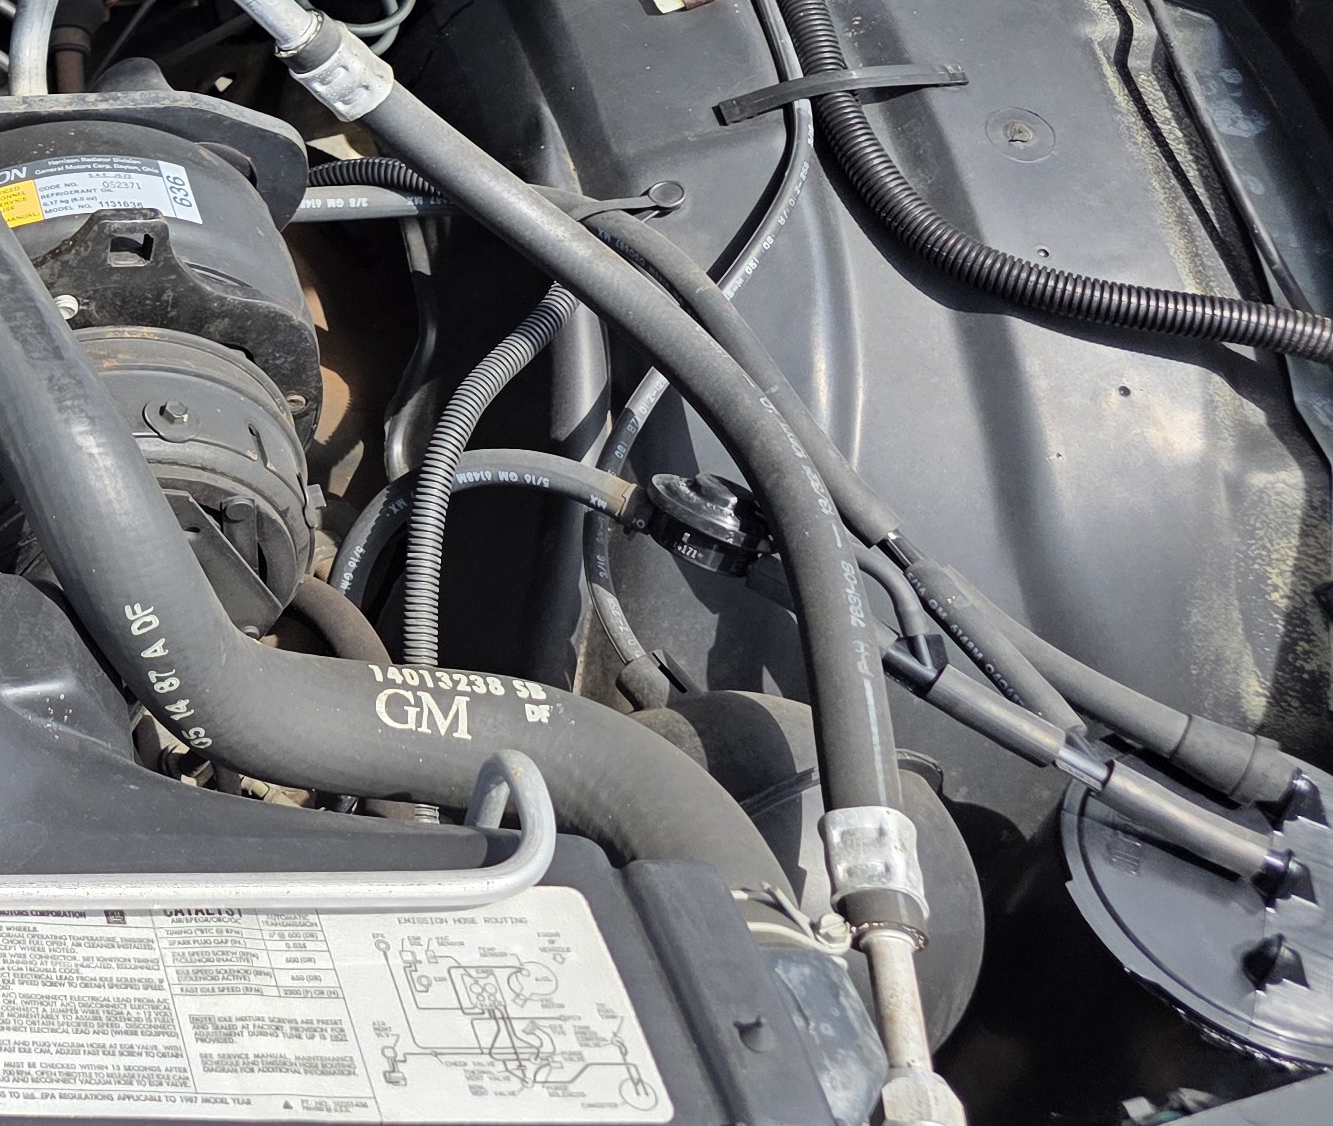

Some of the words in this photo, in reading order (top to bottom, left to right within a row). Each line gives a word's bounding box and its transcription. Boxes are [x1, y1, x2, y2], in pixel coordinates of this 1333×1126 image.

[35, 166, 64, 175] General
[65, 163, 92, 171] Motors
[39, 183, 65, 192] CODE
[102, 181, 141, 190] 052371
[41, 188, 98, 199] REFRIGERANT
[168, 175, 192, 208] 636
[327, 198, 344, 208] GM
[349, 197, 368, 208] 3/8
[455, 470, 492, 484] 6148M
[498, 470, 518, 483] GM
[524, 473, 549, 488] 5/16
[589, 494, 607, 510] MX
[140, 638, 169, 658] A
[148, 668, 180, 693] 87
[368, 664, 505, 696] 14013238
[376, 689, 472, 740] GM
[397, 916, 449, 925] EMISSION
[483, 916, 528, 925] ROUTING
